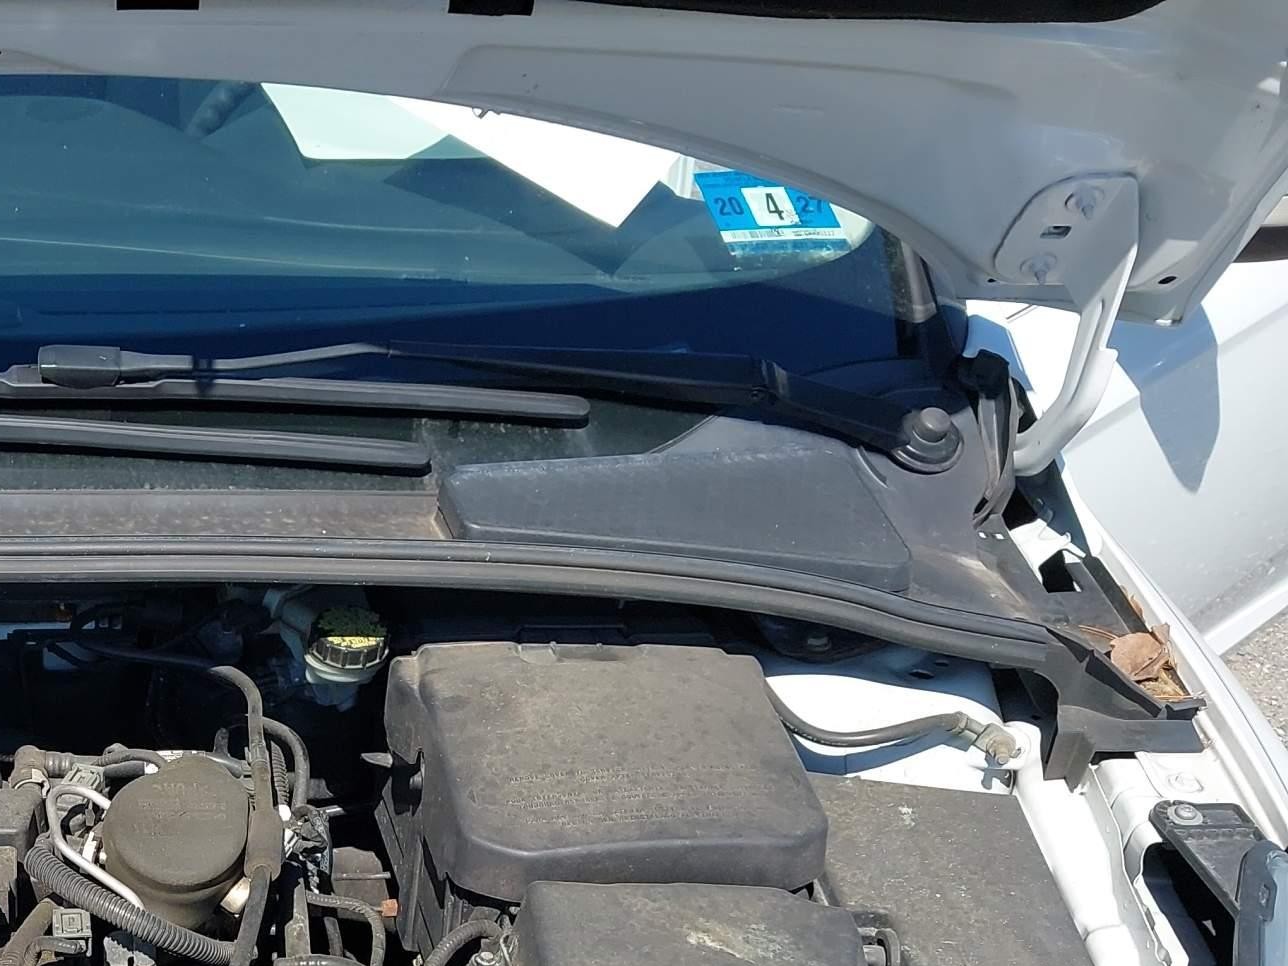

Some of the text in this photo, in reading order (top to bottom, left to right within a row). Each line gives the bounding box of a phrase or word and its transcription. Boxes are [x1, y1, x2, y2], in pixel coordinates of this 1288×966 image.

[714, 193, 824, 220] 20 4 27
